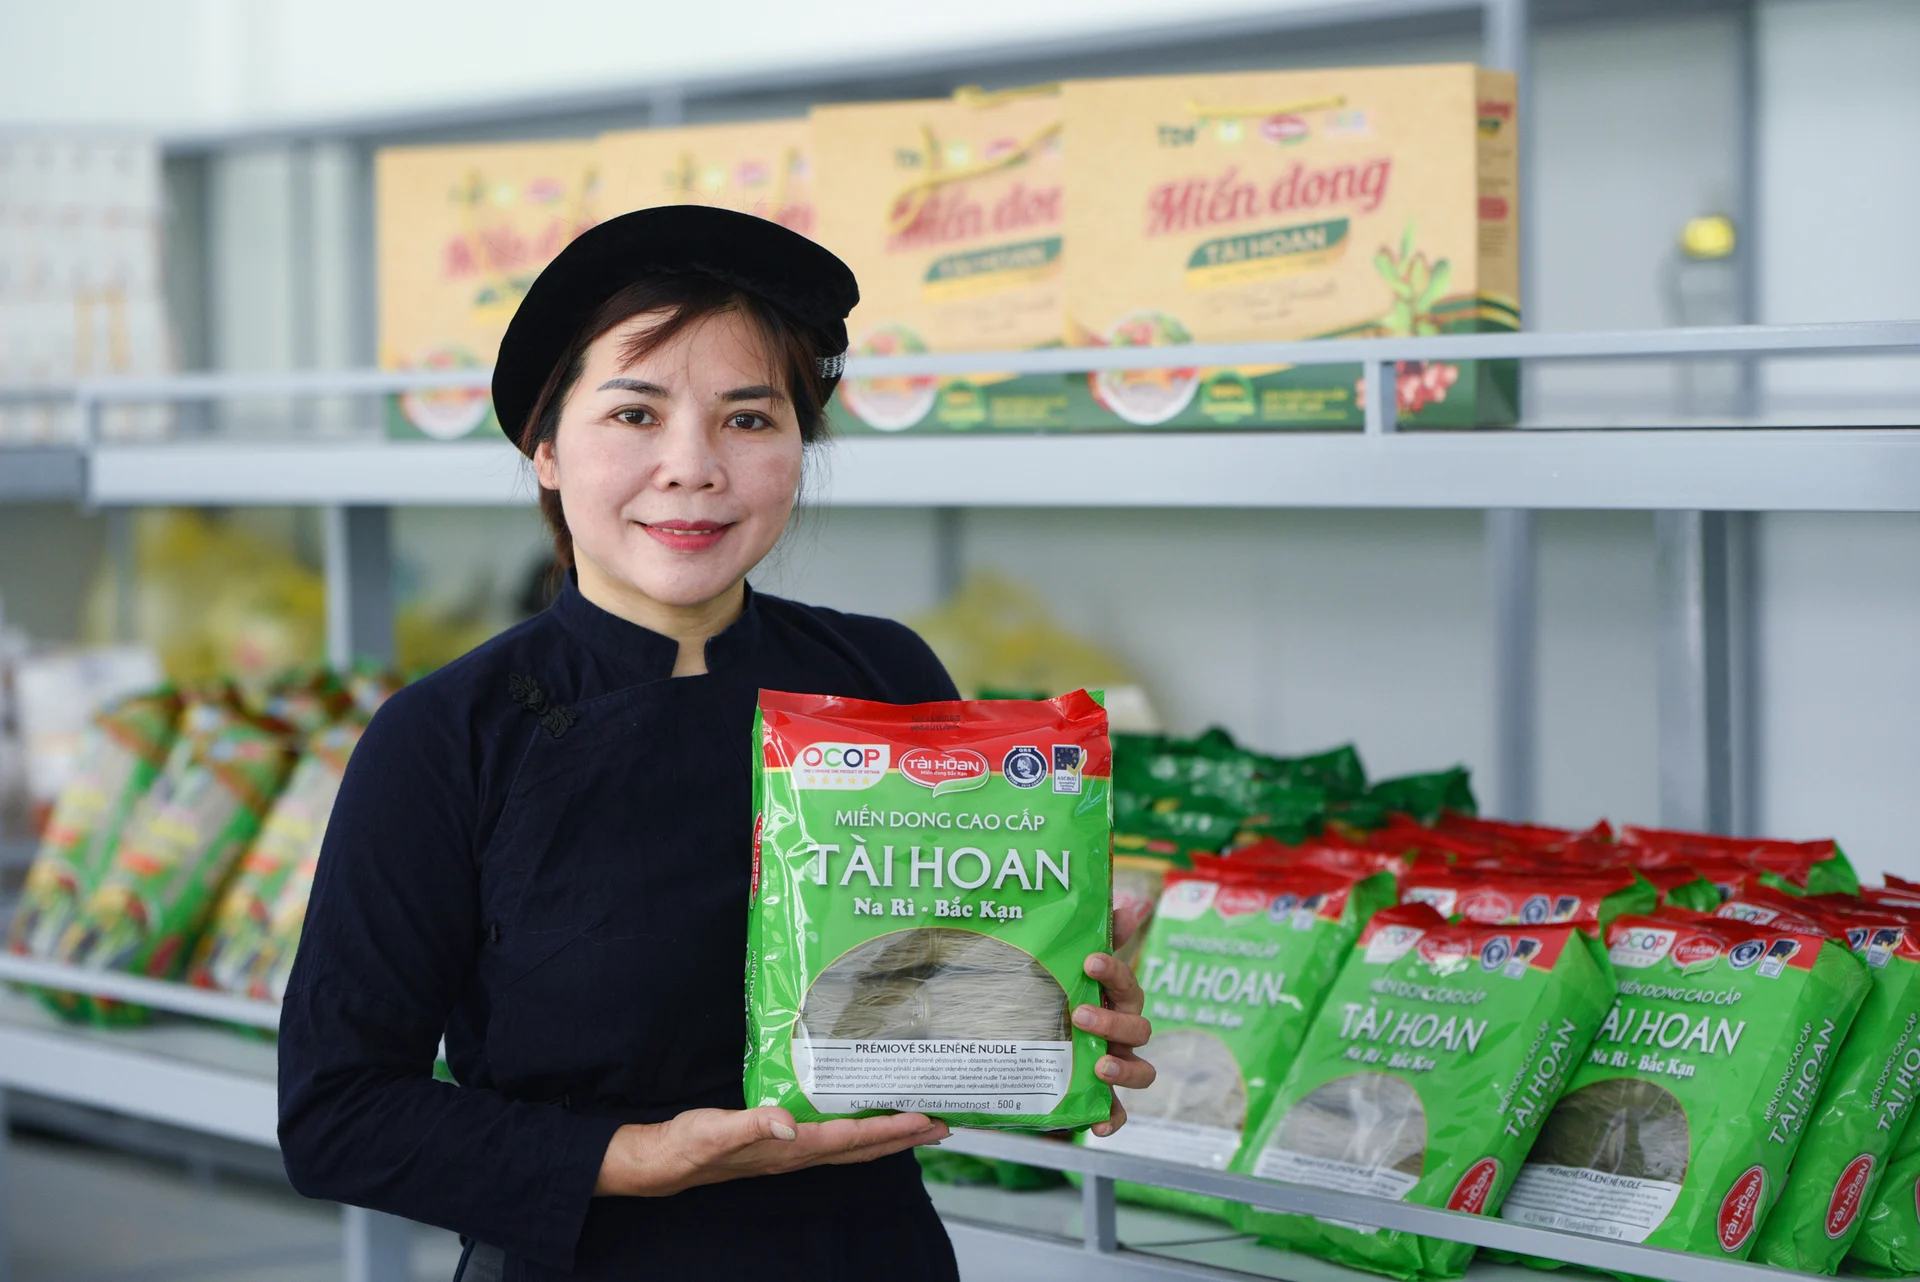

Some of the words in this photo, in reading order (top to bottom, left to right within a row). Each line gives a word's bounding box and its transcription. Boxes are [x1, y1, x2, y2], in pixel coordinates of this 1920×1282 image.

[1270, 158, 1392, 216] dong
[803, 747, 880, 768] OCOP
[834, 804, 885, 827] MIẾN
[890, 811, 951, 829] DONG
[955, 813, 1001, 830] CAO
[1005, 808, 1045, 831] CẤP
[806, 833, 895, 887] TÀI
[909, 846, 1071, 891] HOAN
[853, 897, 884, 916] Na
[890, 898, 916, 917] Rì
[934, 896, 973, 918] Bắc
[979, 900, 1023, 923] Kạn
[1618, 931, 1668, 952] OCOP
[1142, 951, 1192, 996] TÀI
[1188, 962, 1286, 1007] HOAN
[1643, 983, 1685, 1002] DONG
[1684, 989, 1715, 1004] CAO
[855, 1042, 916, 1054] PRÉMIOVÉ
[918, 1042, 976, 1054] SKLENĚNÉ
[978, 1044, 1017, 1054] NUDLE
[1339, 997, 1394, 1041] TÀI
[1387, 1012, 1488, 1054] HOAN
[1594, 999, 1637, 1043] ÀI
[1631, 1008, 1747, 1056] HOAN
[1504, 1095, 1536, 1138] TÀI
[1528, 1017, 1577, 1099] HOAN
[1589, 1048, 1607, 1065] Na
[1610, 1049, 1629, 1069] Rì
[1638, 1053, 1666, 1074] Bắc
[1666, 1059, 1696, 1080] Kạn
[1768, 1101, 1799, 1146] TÀI
[1791, 1018, 1836, 1102] HOAN
[1775, 1066, 1794, 1101] DONG
[1789, 1042, 1804, 1068] CAO
[1877, 1088, 1906, 1133] TÀI
[1896, 1034, 1920, 1090] HO
[1878, 1054, 1897, 1089] DONG
[1893, 1033, 1909, 1059] CAO
[850, 1100, 874, 1109] KLT/
[876, 1100, 893, 1109] Net
[895, 1099, 915, 1108] WT/
[917, 1098, 942, 1109] Čistá
[944, 1100, 990, 1110] hmotnost
[997, 1099, 1014, 1109] 500
[1016, 1102, 1022, 1110] g
